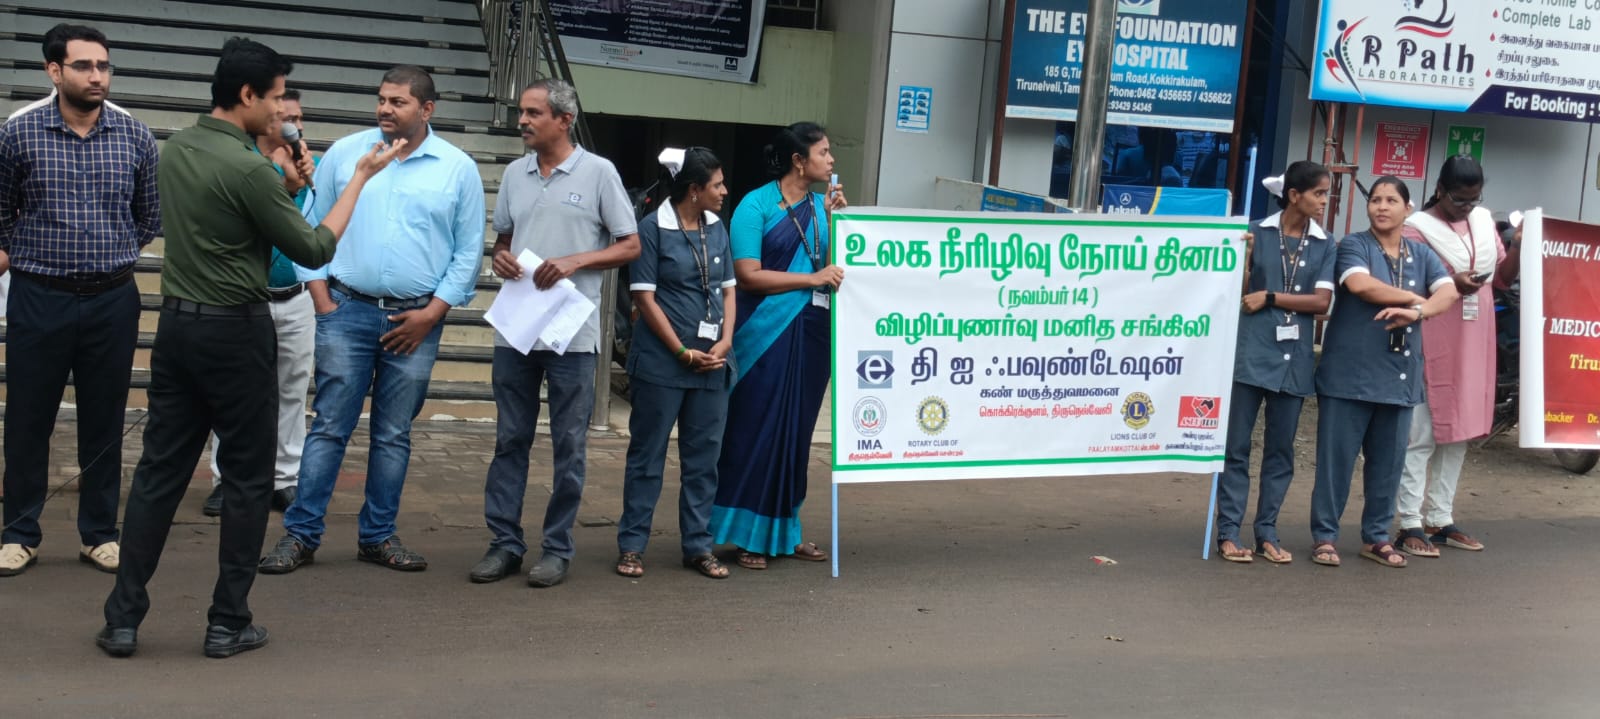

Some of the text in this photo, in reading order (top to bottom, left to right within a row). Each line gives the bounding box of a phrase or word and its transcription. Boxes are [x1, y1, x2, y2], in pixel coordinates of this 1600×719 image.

[1026, 8, 1066, 34] THE
[1069, 12, 1088, 36] EY
[1502, 7, 1592, 31] Complete Lab
[1066, 39, 1189, 71] EY OSPITAL
[1361, 35, 1383, 67] R
[1044, 65, 1060, 77] 185
[1358, 67, 1475, 87] LABORATORIES
[1504, 91, 1529, 110] For
[1530, 93, 1587, 119] Booking
[845, 226, 1237, 282] உலக நீரிழிவு நோய் தினம்
[1541, 240, 1592, 262] QUALITY,
[1072, 287, 1089, 305] 14
[875, 312, 1211, 345] விழிப்புணர்வு மனித சங்கிலி
[911, 347, 938, 386] தி
[950, 356, 975, 385] ஐ
[1569, 353, 1600, 371] Tiru
[979, 384, 1120, 401] கண் மருத்துவமனை
[857, 439, 883, 450] IMA
